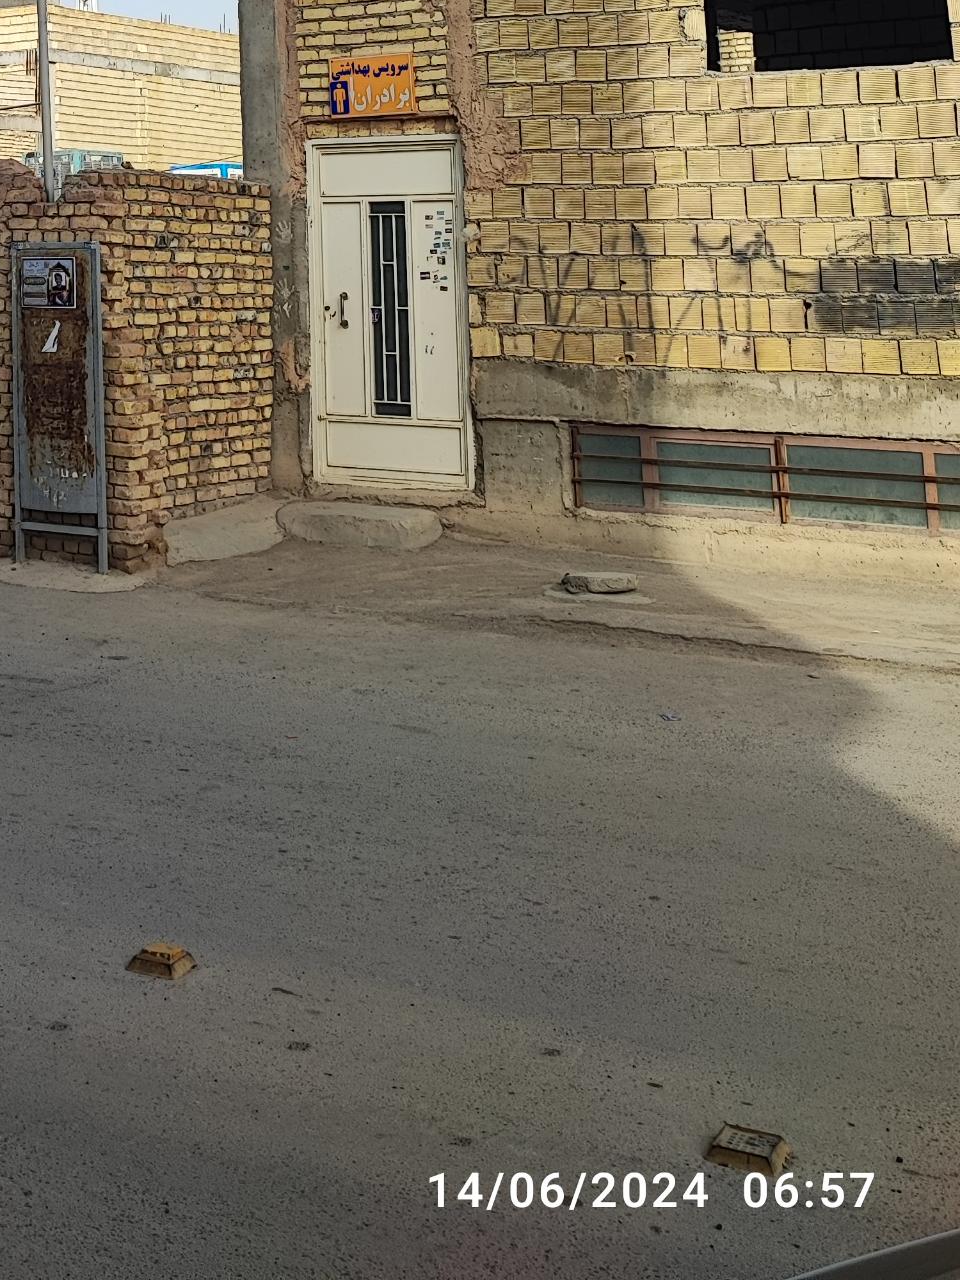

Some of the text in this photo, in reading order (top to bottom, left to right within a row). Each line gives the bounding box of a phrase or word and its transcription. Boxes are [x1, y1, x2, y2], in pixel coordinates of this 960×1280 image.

[331, 61, 409, 80] سرویس بهداشتی
[353, 82, 410, 112] برادران
